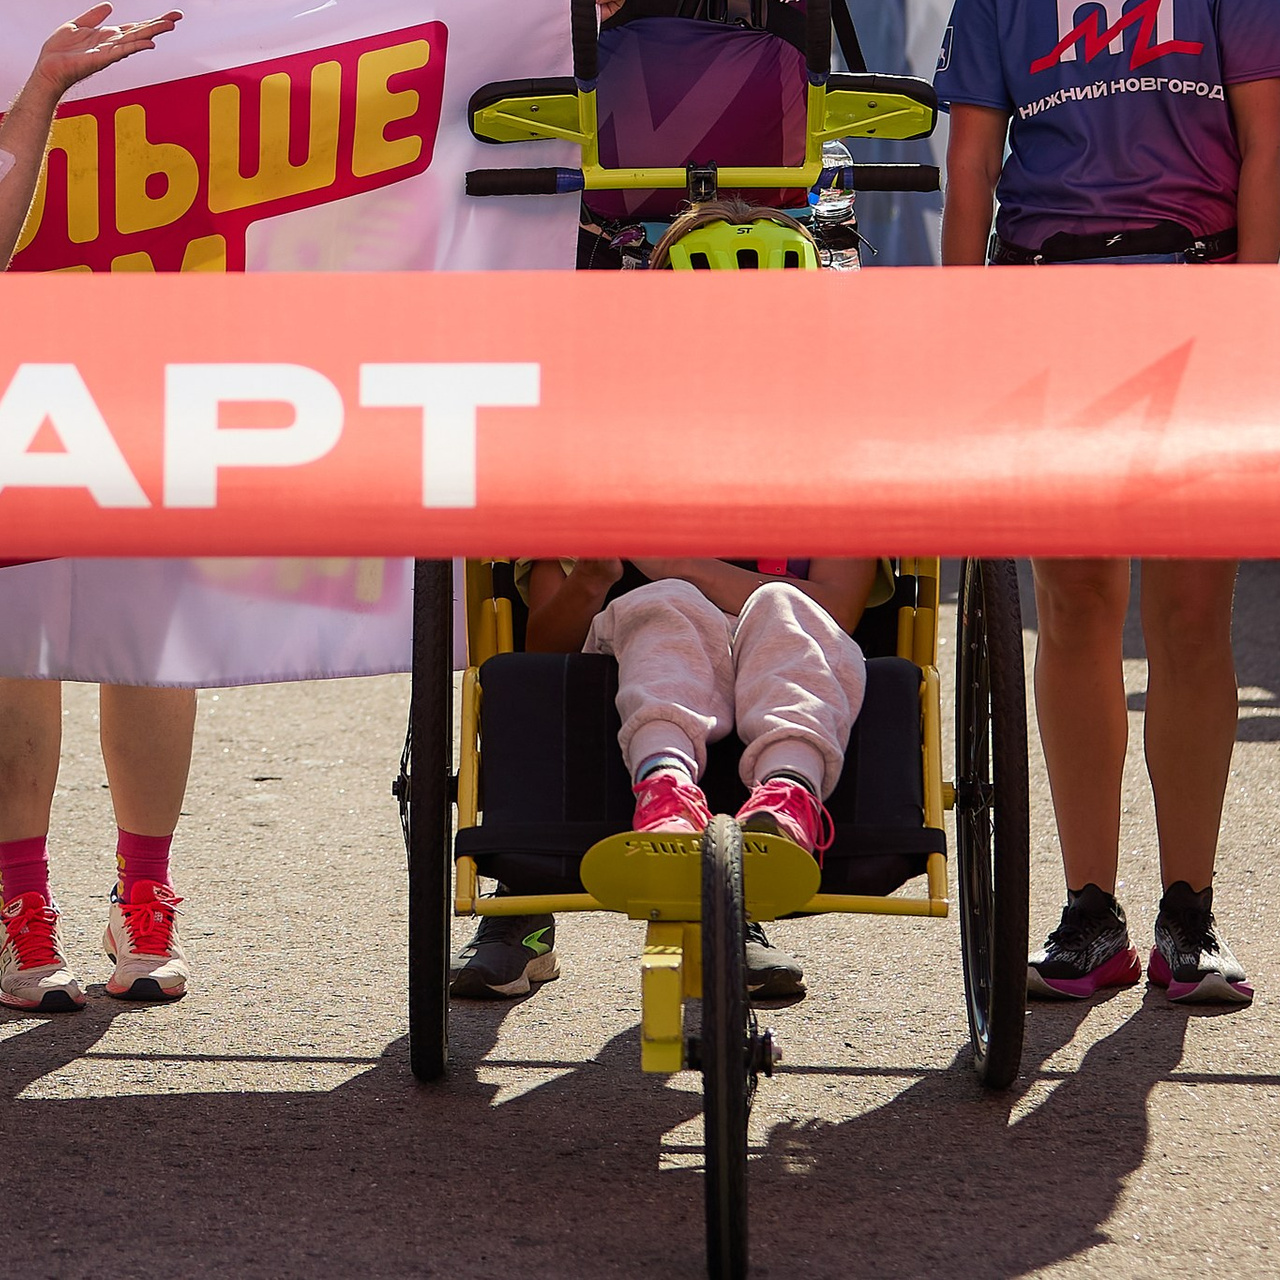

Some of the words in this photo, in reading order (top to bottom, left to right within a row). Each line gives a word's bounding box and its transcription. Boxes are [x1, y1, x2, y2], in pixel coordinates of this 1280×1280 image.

[1019, 80, 1108, 120] НИЖНИЙ
[1110, 77, 1225, 102] НОВГОРОД
[736, 227, 753, 235] ST
